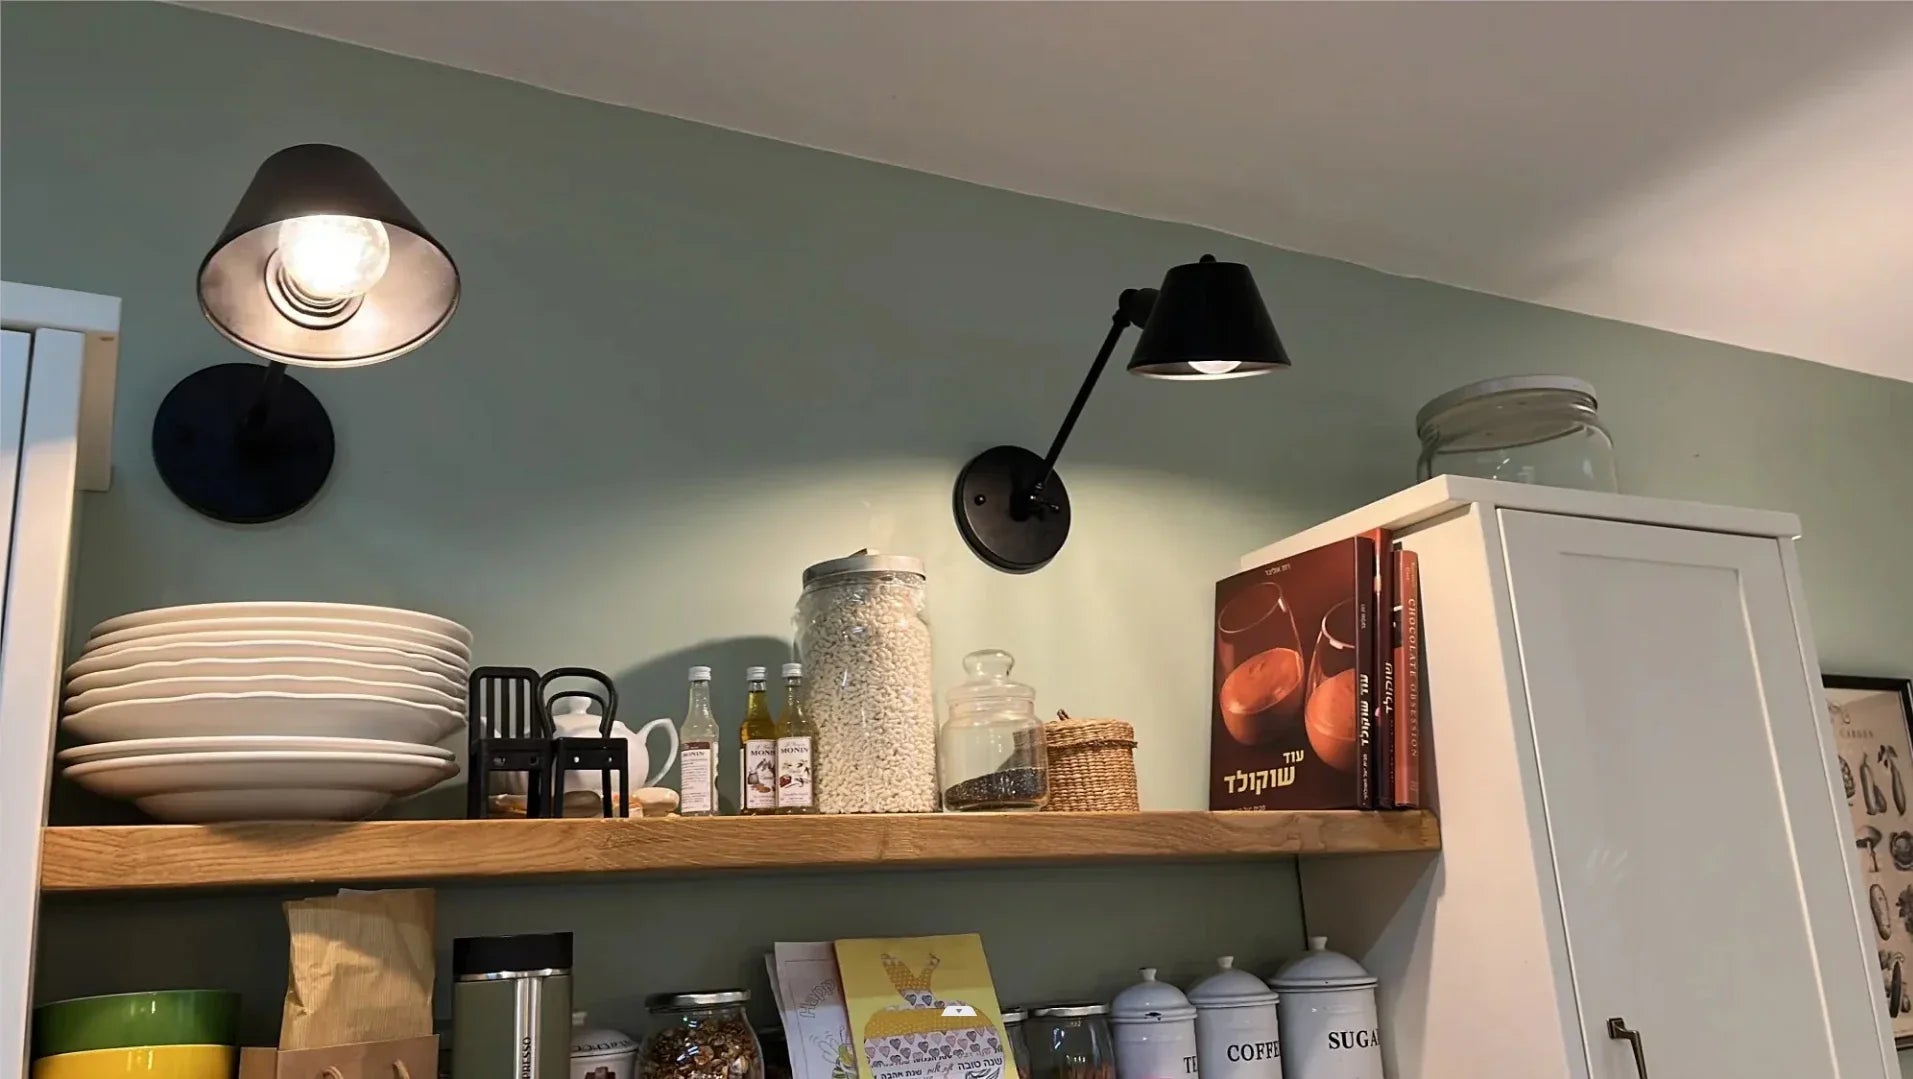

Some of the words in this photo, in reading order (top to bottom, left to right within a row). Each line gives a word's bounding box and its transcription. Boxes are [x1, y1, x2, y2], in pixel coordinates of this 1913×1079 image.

[1408, 598, 1417, 677] CHOCOLATE
[1360, 673, 1369, 696] עוד
[1382, 662, 1394, 714] שוקולד
[1359, 700, 1371, 747] שוקולד
[1409, 684, 1418, 757] OBSESSION
[780, 747, 809, 755] MONIN
[1282, 749, 1305, 764] עוד
[1223, 766, 1296, 795] שוקולד
[1328, 1029, 1380, 1050] SUGA
[957, 1060, 982, 1070] טובה
[983, 1057, 1003, 1067] שנה
